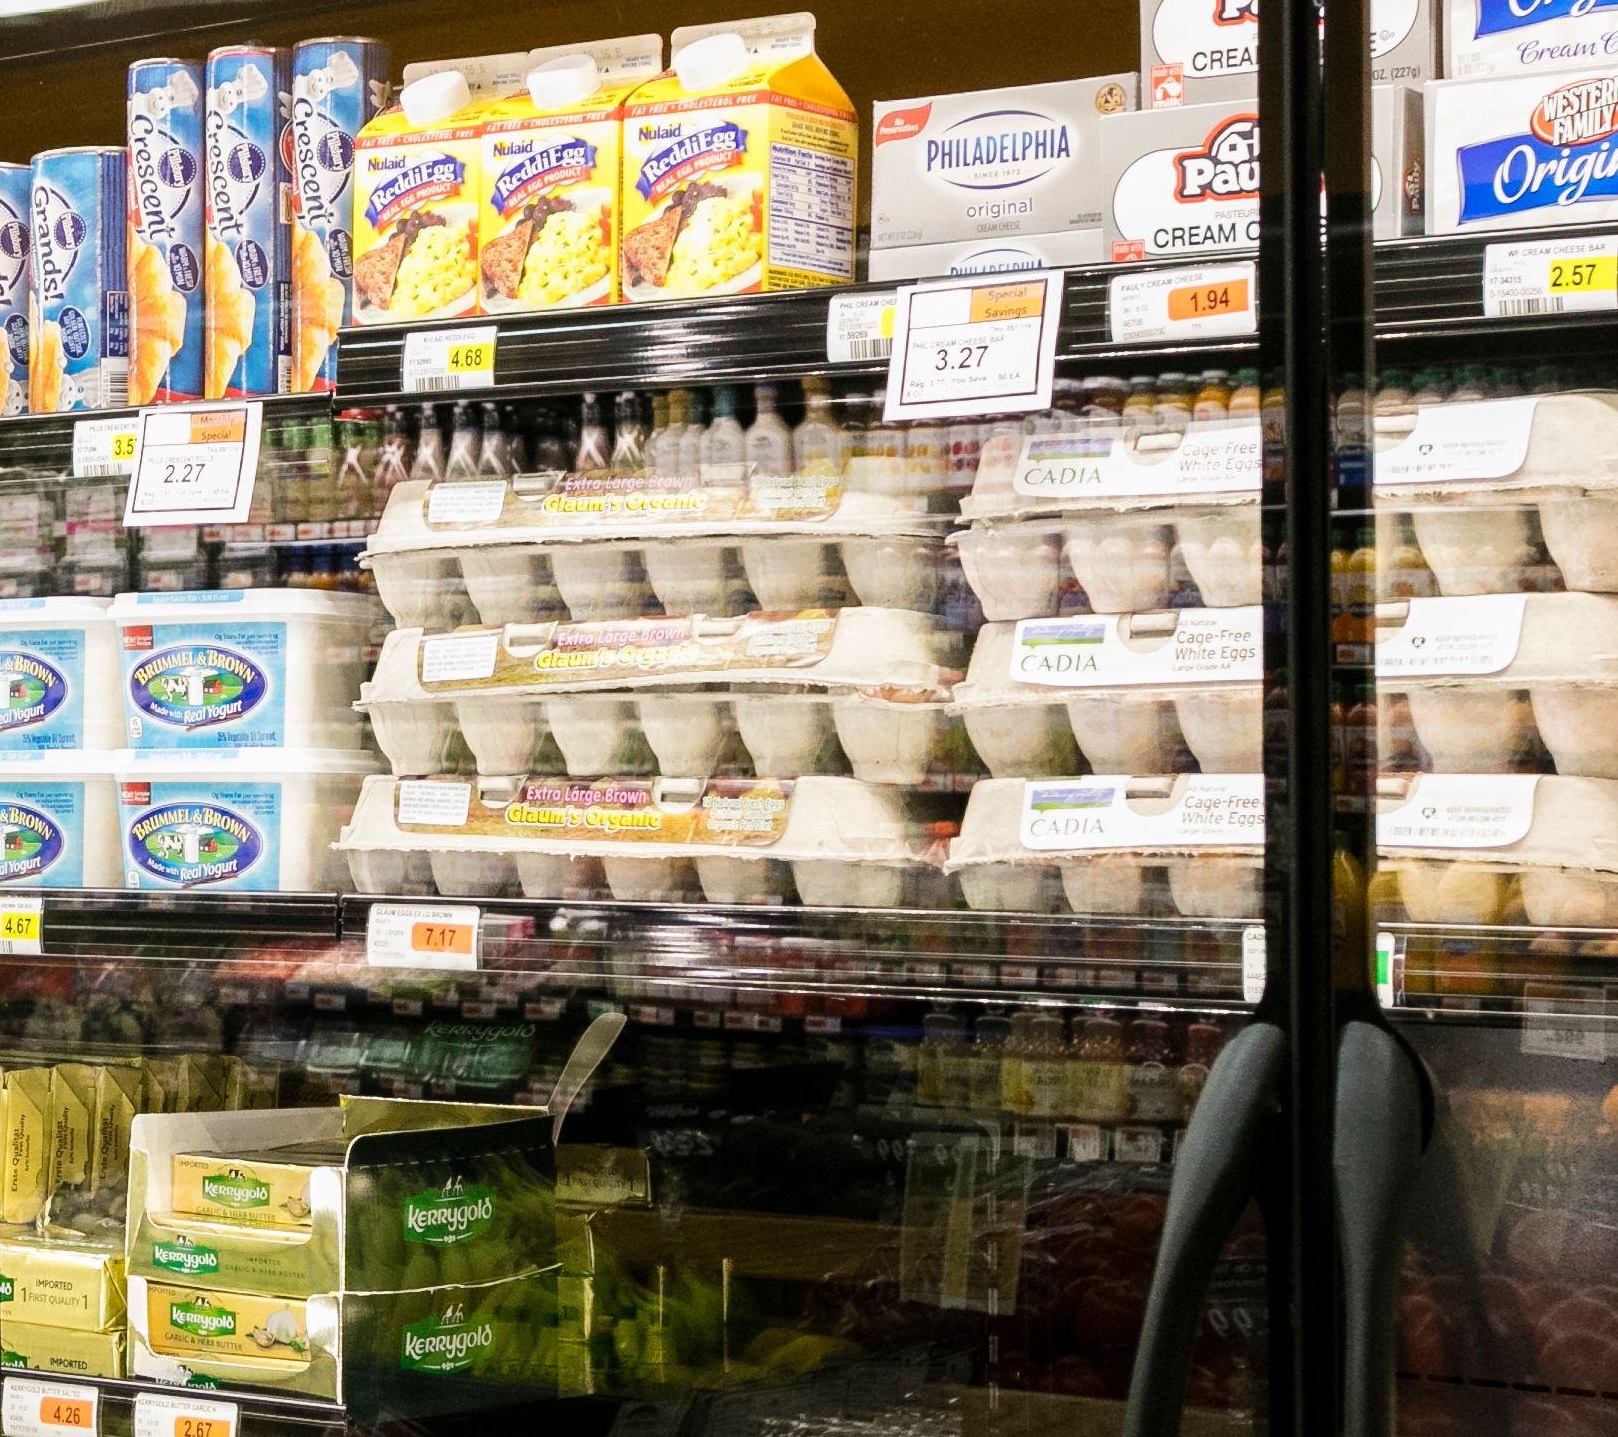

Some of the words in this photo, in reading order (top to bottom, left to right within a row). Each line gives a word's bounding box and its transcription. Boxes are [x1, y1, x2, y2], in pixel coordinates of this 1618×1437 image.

[1516, 34, 1599, 66] Cream
[879, 122, 919, 137] Preservatives
[893, 116, 905, 126] No
[926, 124, 1071, 173] PHILADELPHIA
[293, 97, 326, 228] Crescent
[368, 156, 406, 172] Nulaid
[372, 163, 454, 209] ReddiEgg
[382, 203, 400, 221] REAL
[400, 193, 415, 208] EGG
[415, 182, 452, 201] PRODUCT
[966, 196, 1033, 220] original
[976, 222, 999, 233] CREAM
[1000, 220, 1021, 231] CHEESE
[33, 186, 64, 303] Grands!
[1508, 249, 1520, 258] WF
[1522, 248, 1551, 257] CREAM
[1553, 245, 1585, 255] CHEESE
[1587, 243, 1606, 253] BAR
[1121, 282, 1145, 292] PAULY
[1147, 277, 1173, 288] CREAM
[1174, 273, 1203, 285] CHEESE
[1551, 264, 1596, 287] 2.57
[988, 287, 1027, 302] Special
[1190, 288, 1230, 313] 1.94
[985, 306, 1027, 319] Savings
[451, 349, 482, 367] 4.68
[935, 346, 988, 371] 3.27
[163, 463, 205, 485] 2.27
[135, 649, 195, 685] BRUMMEL
[207, 650, 255, 683] BROWN
[150, 702, 168, 716] Made
[169, 709, 183, 720] with
[183, 705, 206, 724] Real
[207, 700, 242, 723] Yogurt
[425, 927, 456, 946] 7.17
[204, 1181, 268, 1202] Kerrygold
[36, 1279, 73, 1291] IMPORTED
[29, 1292, 48, 1303] FIRST
[49, 1294, 80, 1306] QUALITY
[53, 1408, 81, 1425] 4.26
